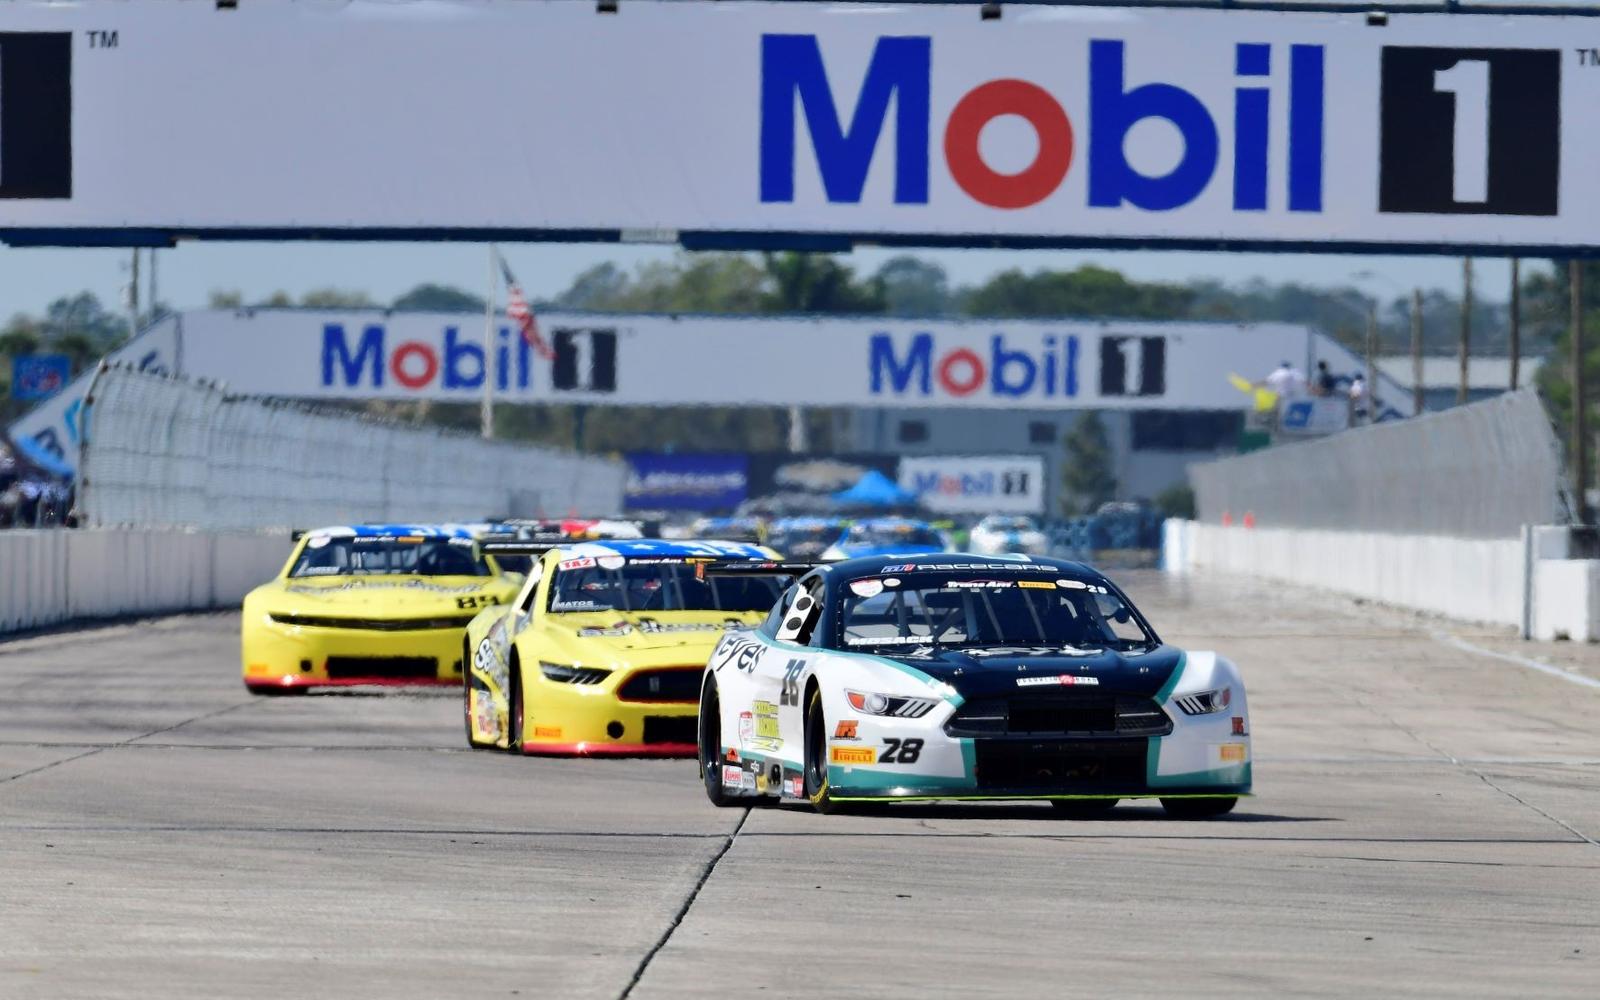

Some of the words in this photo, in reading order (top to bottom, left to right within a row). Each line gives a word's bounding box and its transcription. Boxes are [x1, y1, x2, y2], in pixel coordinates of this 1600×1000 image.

[86, 30, 119, 49] TM
[760, 34, 1326, 211] Mobil
[321, 322, 529, 389] Mobil
[869, 332, 1079, 398] Mobil
[557, 600, 594, 608] MATOS
[847, 634, 935, 646] MOSACK
[780, 659, 807, 707] 28
[833, 748, 874, 763] PIRELLI
[878, 737, 925, 764] 28
